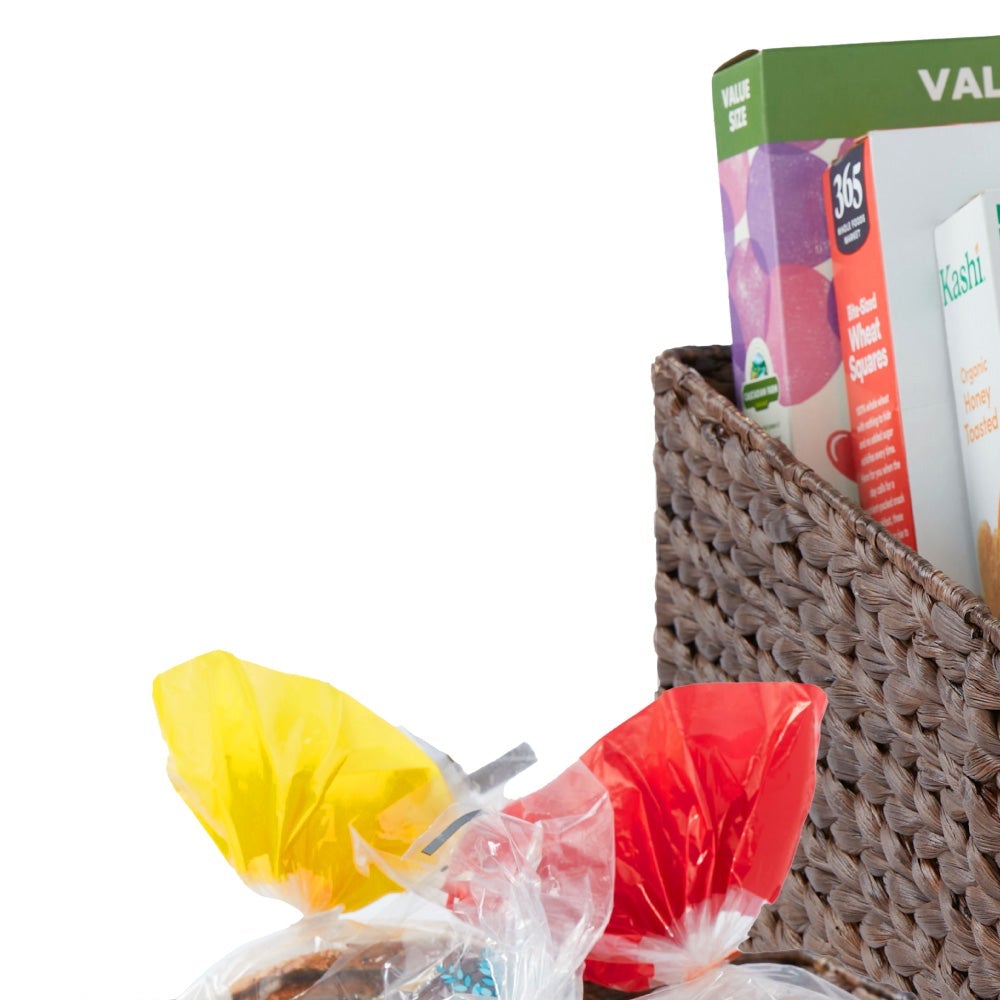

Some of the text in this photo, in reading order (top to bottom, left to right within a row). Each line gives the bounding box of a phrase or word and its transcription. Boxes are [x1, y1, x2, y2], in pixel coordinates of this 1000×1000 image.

[721, 78, 751, 109] VALUE
[728, 105, 748, 133] SIZE
[833, 161, 863, 220] 365
[938, 243, 985, 307] Kashi
[848, 316, 882, 352] Wheat
[849, 347, 888, 384] Squares
[960, 358, 988, 385] Organic
[963, 386, 991, 414] Honey
[963, 407, 998, 445] Toasted
